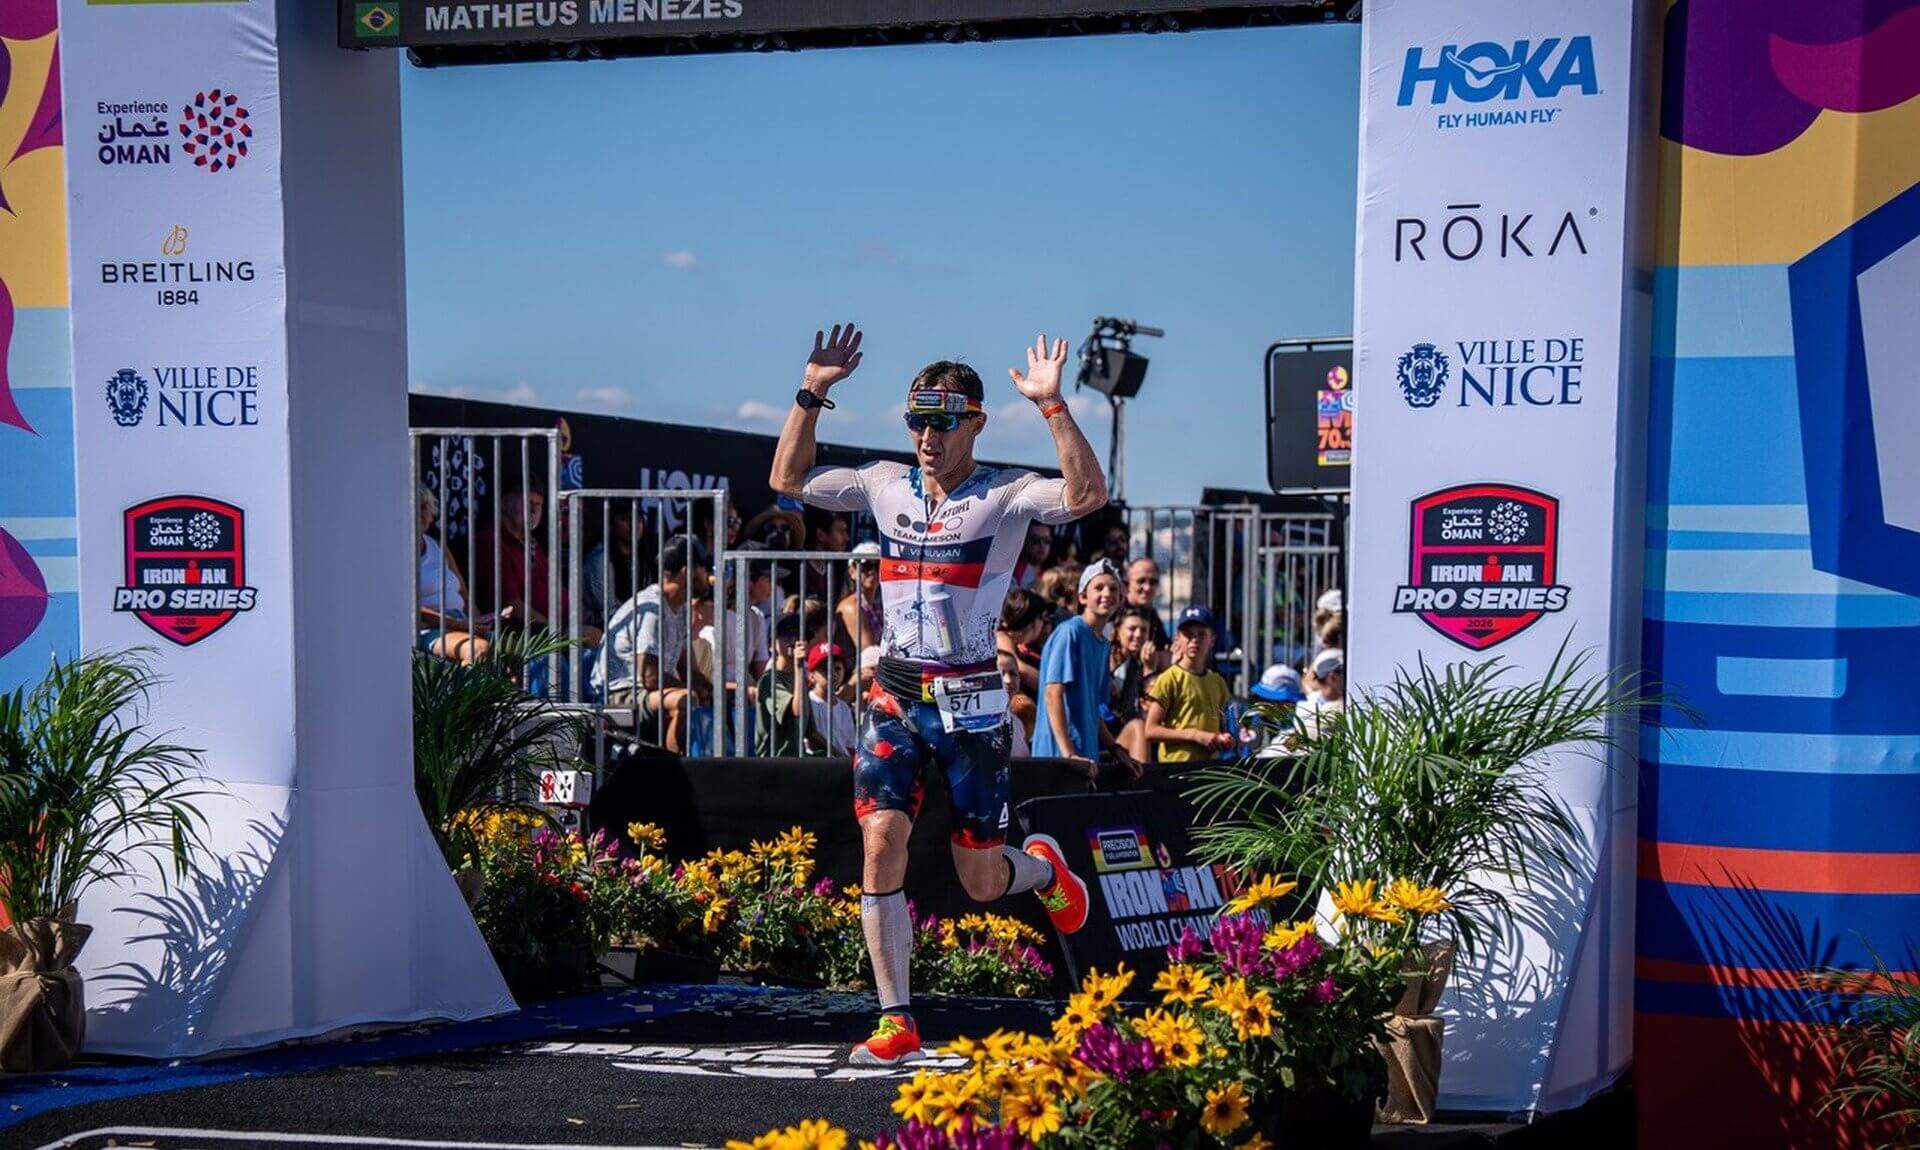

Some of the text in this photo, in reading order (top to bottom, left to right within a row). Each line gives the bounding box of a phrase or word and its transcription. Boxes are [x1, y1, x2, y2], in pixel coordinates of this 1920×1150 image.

[425, 0, 744, 31] MATHEUS MENEZES
[1397, 35, 1598, 106] HOKA
[97, 102, 168, 116] Experience
[1438, 114, 1463, 128] FLY
[1466, 110, 1527, 127] HUMAN
[98, 145, 170, 164] OMAN
[101, 261, 255, 284] BREITLING
[157, 290, 199, 305] 1884
[1456, 338, 1584, 364] VILLE DE
[153, 366, 258, 389] VILLE DE
[1456, 364, 1583, 407] NICE
[156, 390, 259, 427] NICE
[1443, 508, 1483, 516] Experience
[149, 536, 184, 546] OMAN
[1441, 529, 1483, 540] OMAN
[143, 560, 226, 584] IRONMAN
[1431, 555, 1533, 582] IRONMAN
[115, 589, 255, 609] PRO SERIES
[1395, 587, 1568, 610] PRO SERIES
[950, 693, 980, 711] 571
[1115, 919, 1170, 951] WORLD
